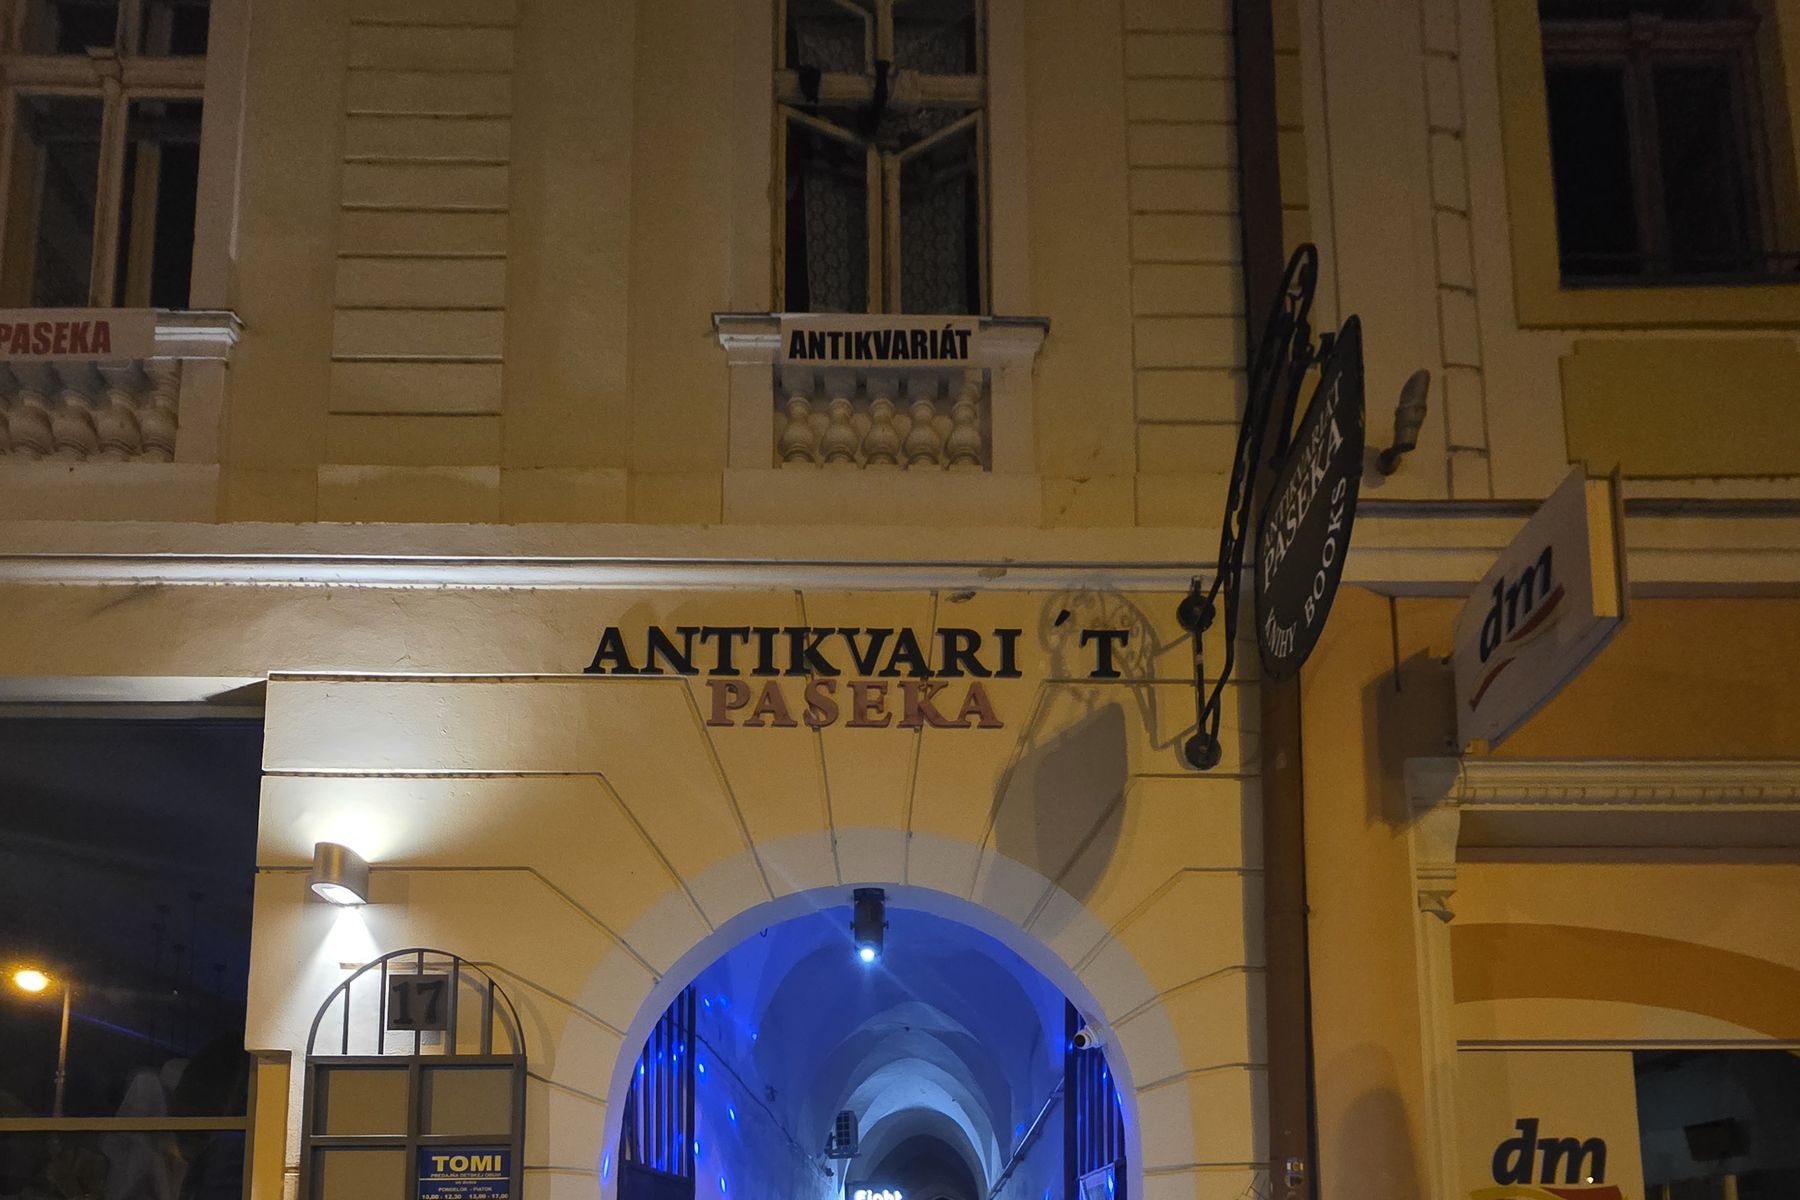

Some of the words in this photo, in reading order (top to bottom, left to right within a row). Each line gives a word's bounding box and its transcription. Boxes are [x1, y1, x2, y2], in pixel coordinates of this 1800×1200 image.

[0, 321, 112, 355] PASEKA
[788, 323, 972, 360] ANTIKVARIÁT
[1263, 417, 1344, 594] PASEKA
[1304, 477, 1347, 628] BOOKS
[1479, 545, 1553, 664] dm
[1264, 606, 1298, 658] KNIHY
[706, 678, 1005, 730] PASEKA
[391, 980, 444, 1025] 17
[431, 1155, 502, 1172] TOMI
[1491, 1117, 1607, 1186] dm
